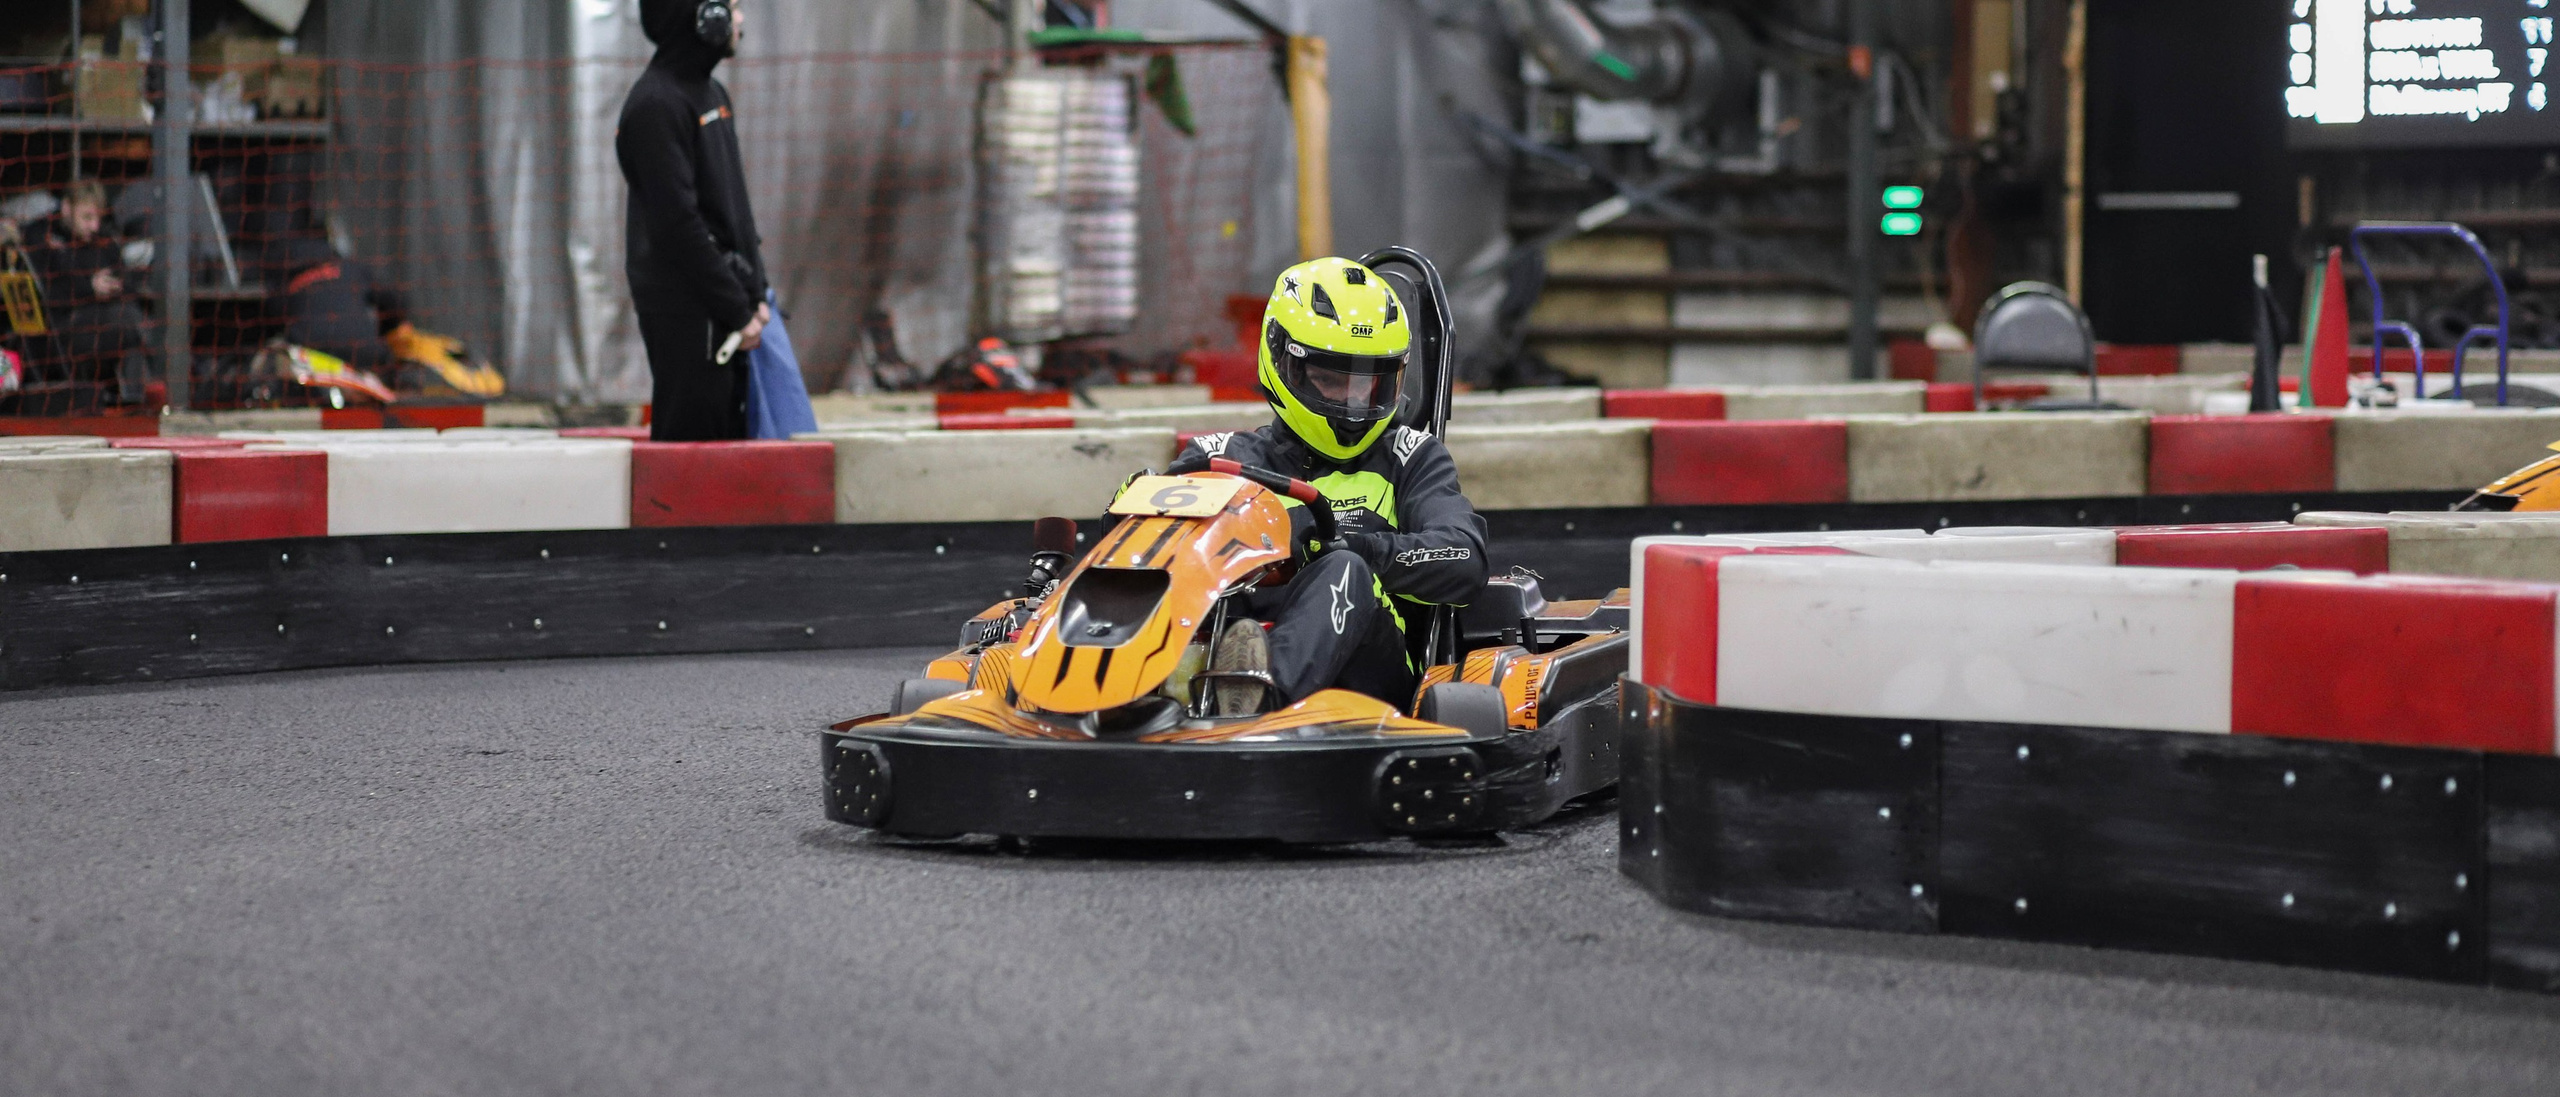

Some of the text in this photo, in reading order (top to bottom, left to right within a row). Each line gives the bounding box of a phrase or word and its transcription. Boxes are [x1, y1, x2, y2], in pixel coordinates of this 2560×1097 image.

[1351, 326, 1373, 336] OMP
[1290, 344, 1304, 355] BELL
[1149, 485, 1203, 508] 6
[1396, 547, 1470, 566] alpinestars
